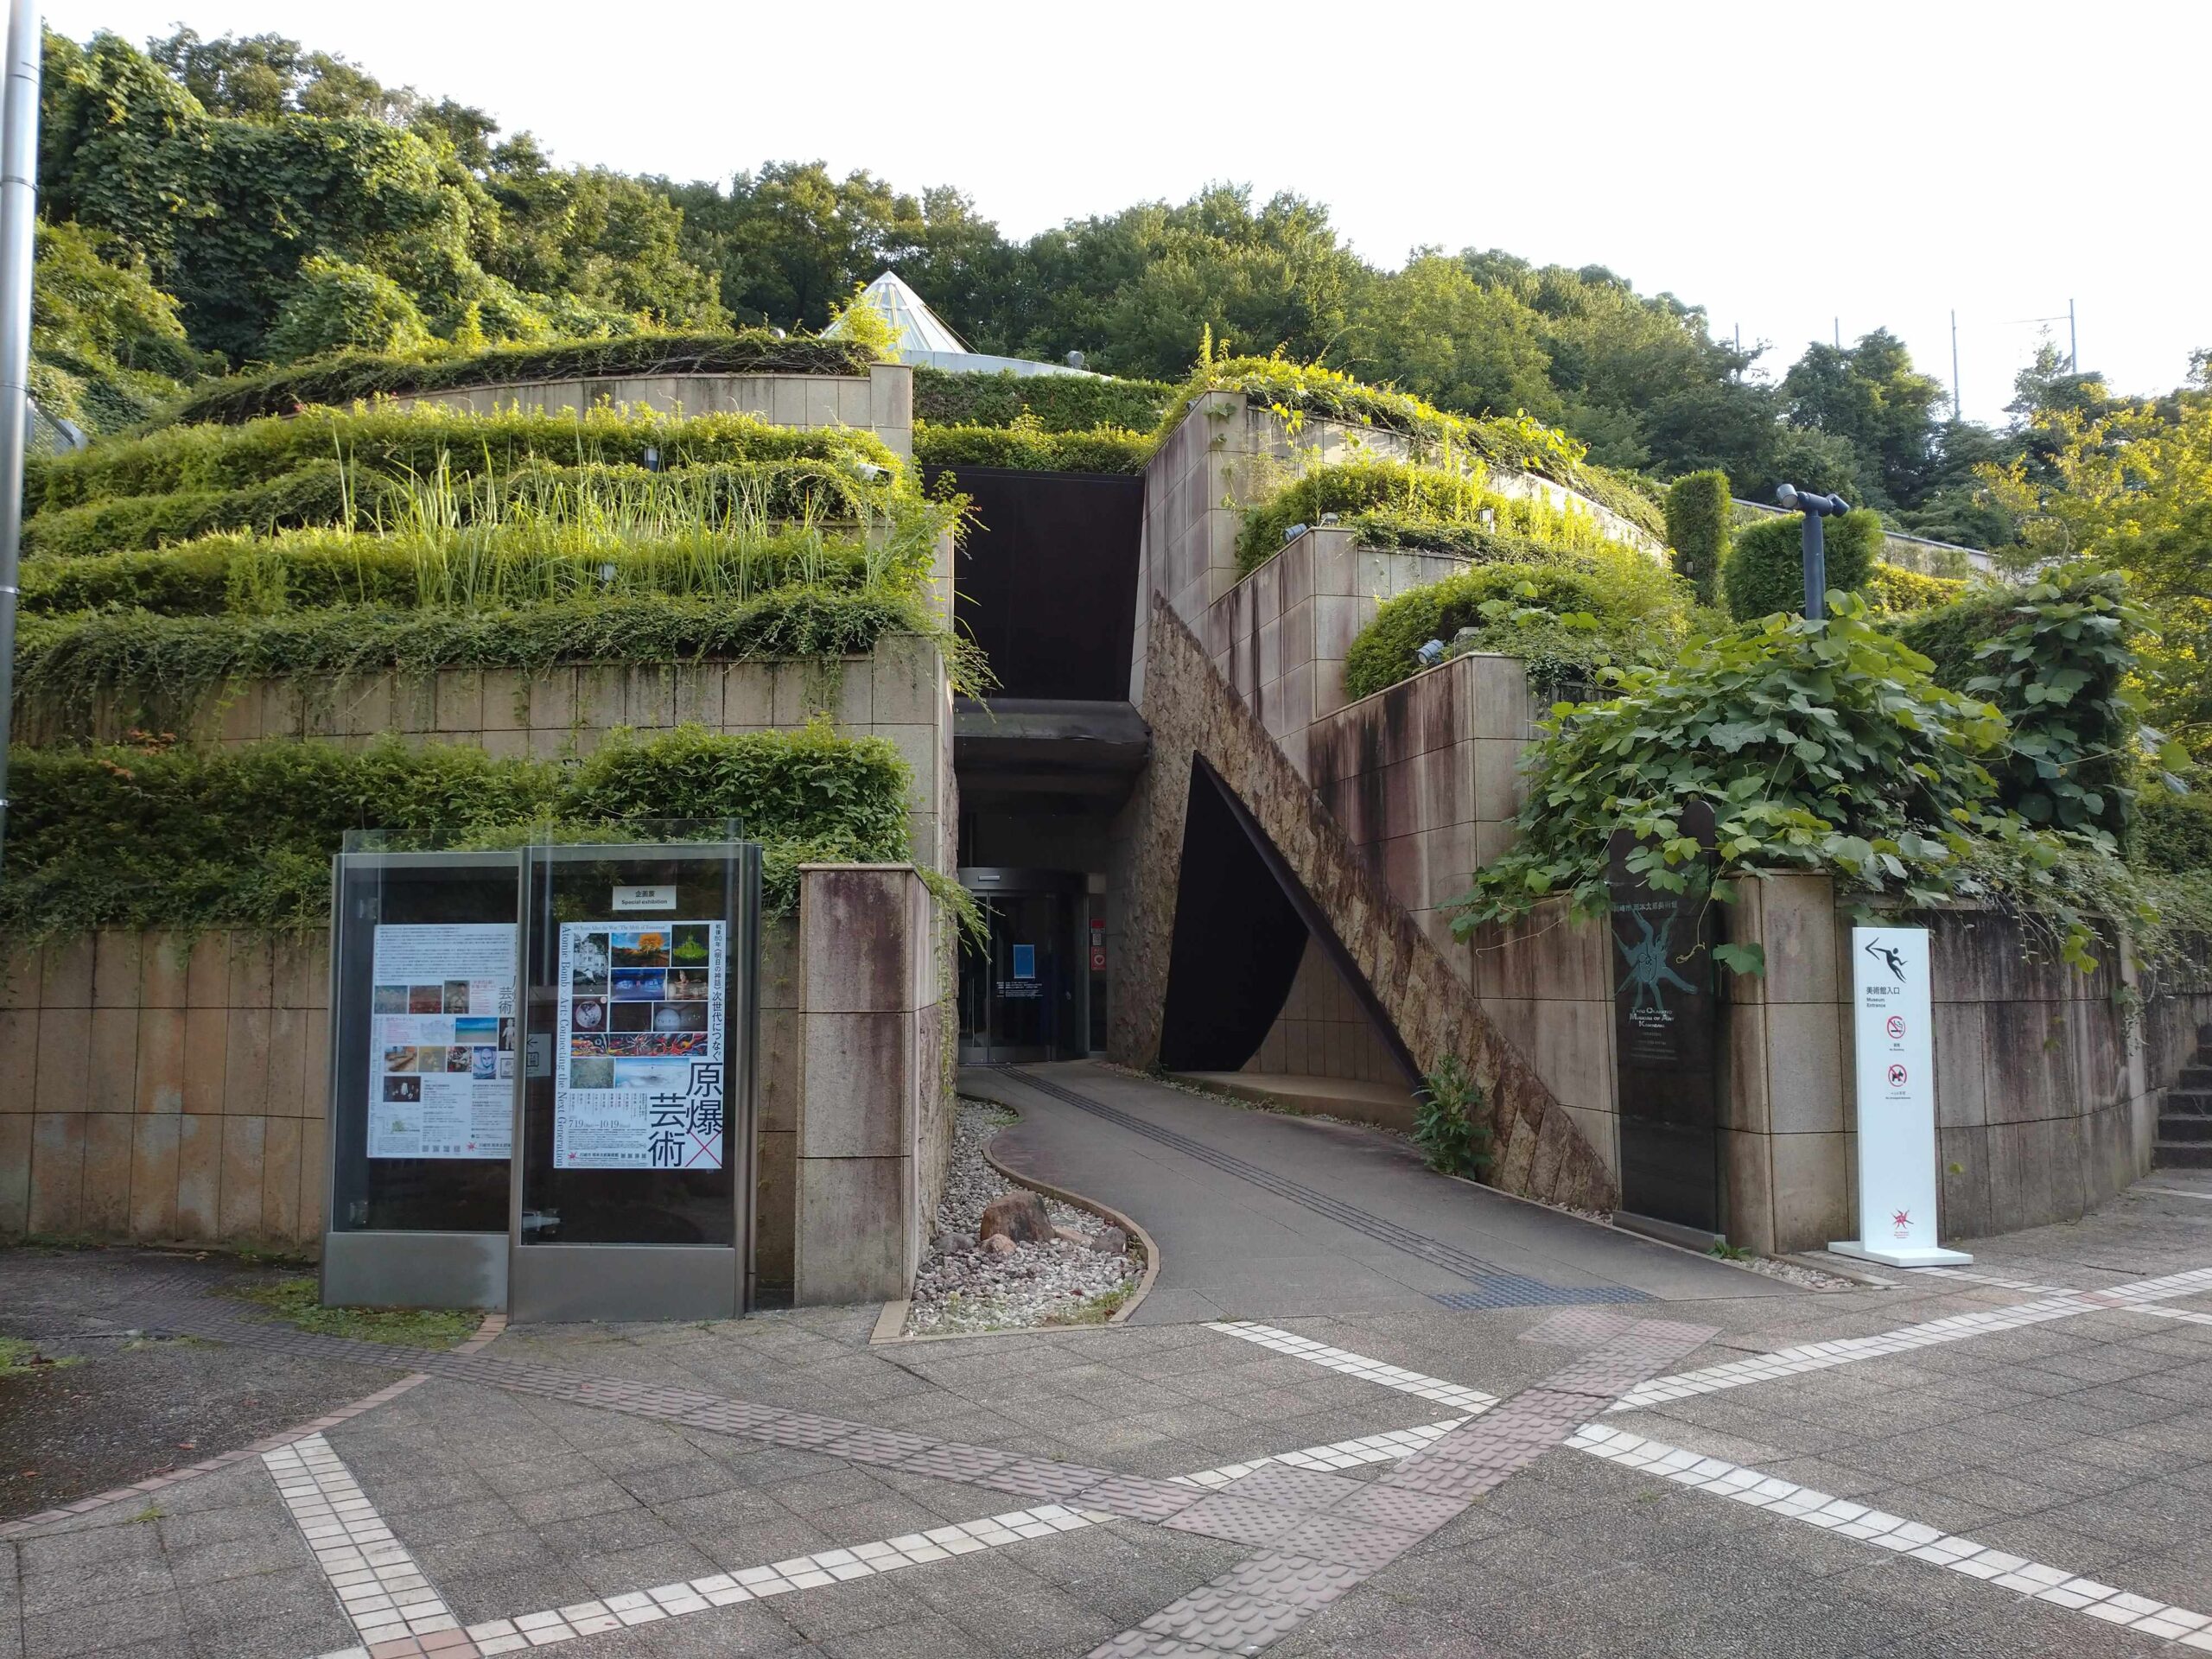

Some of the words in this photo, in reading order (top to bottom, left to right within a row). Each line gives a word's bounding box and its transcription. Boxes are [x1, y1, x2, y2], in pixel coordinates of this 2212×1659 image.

[560, 925, 571, 957] Atomic
[560, 961, 570, 987] Bomb
[1866, 986, 1900, 995] 美術館入口
[559, 996, 569, 1016] Art:
[711, 991, 723, 1061] 次世代につなぐ
[556, 1019, 569, 1071] Connecting
[558, 1072, 567, 1089] the
[557, 1091, 567, 1113] Next
[556, 1116, 567, 1166] Generation
[647, 1092, 687, 1167] 芸術
